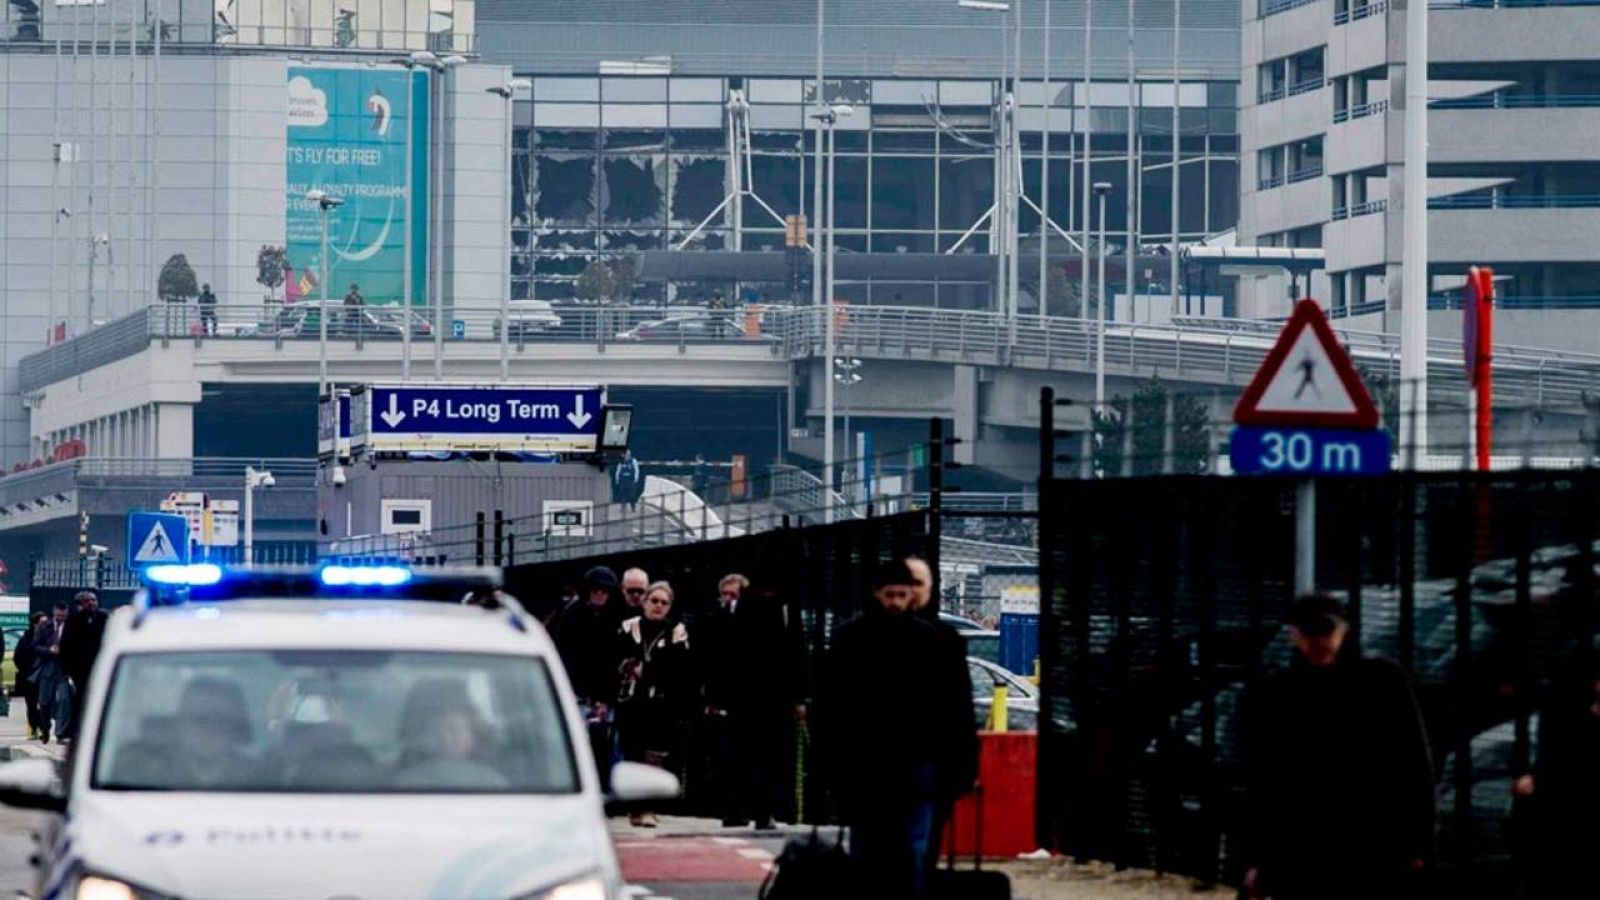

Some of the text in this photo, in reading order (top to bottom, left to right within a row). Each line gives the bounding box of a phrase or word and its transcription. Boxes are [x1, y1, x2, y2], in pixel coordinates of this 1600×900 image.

[305, 148, 322, 164] FLY
[325, 148, 349, 165] FOR
[413, 398, 560, 423] P4 Long Term
[1260, 432, 1361, 470] 30 m
